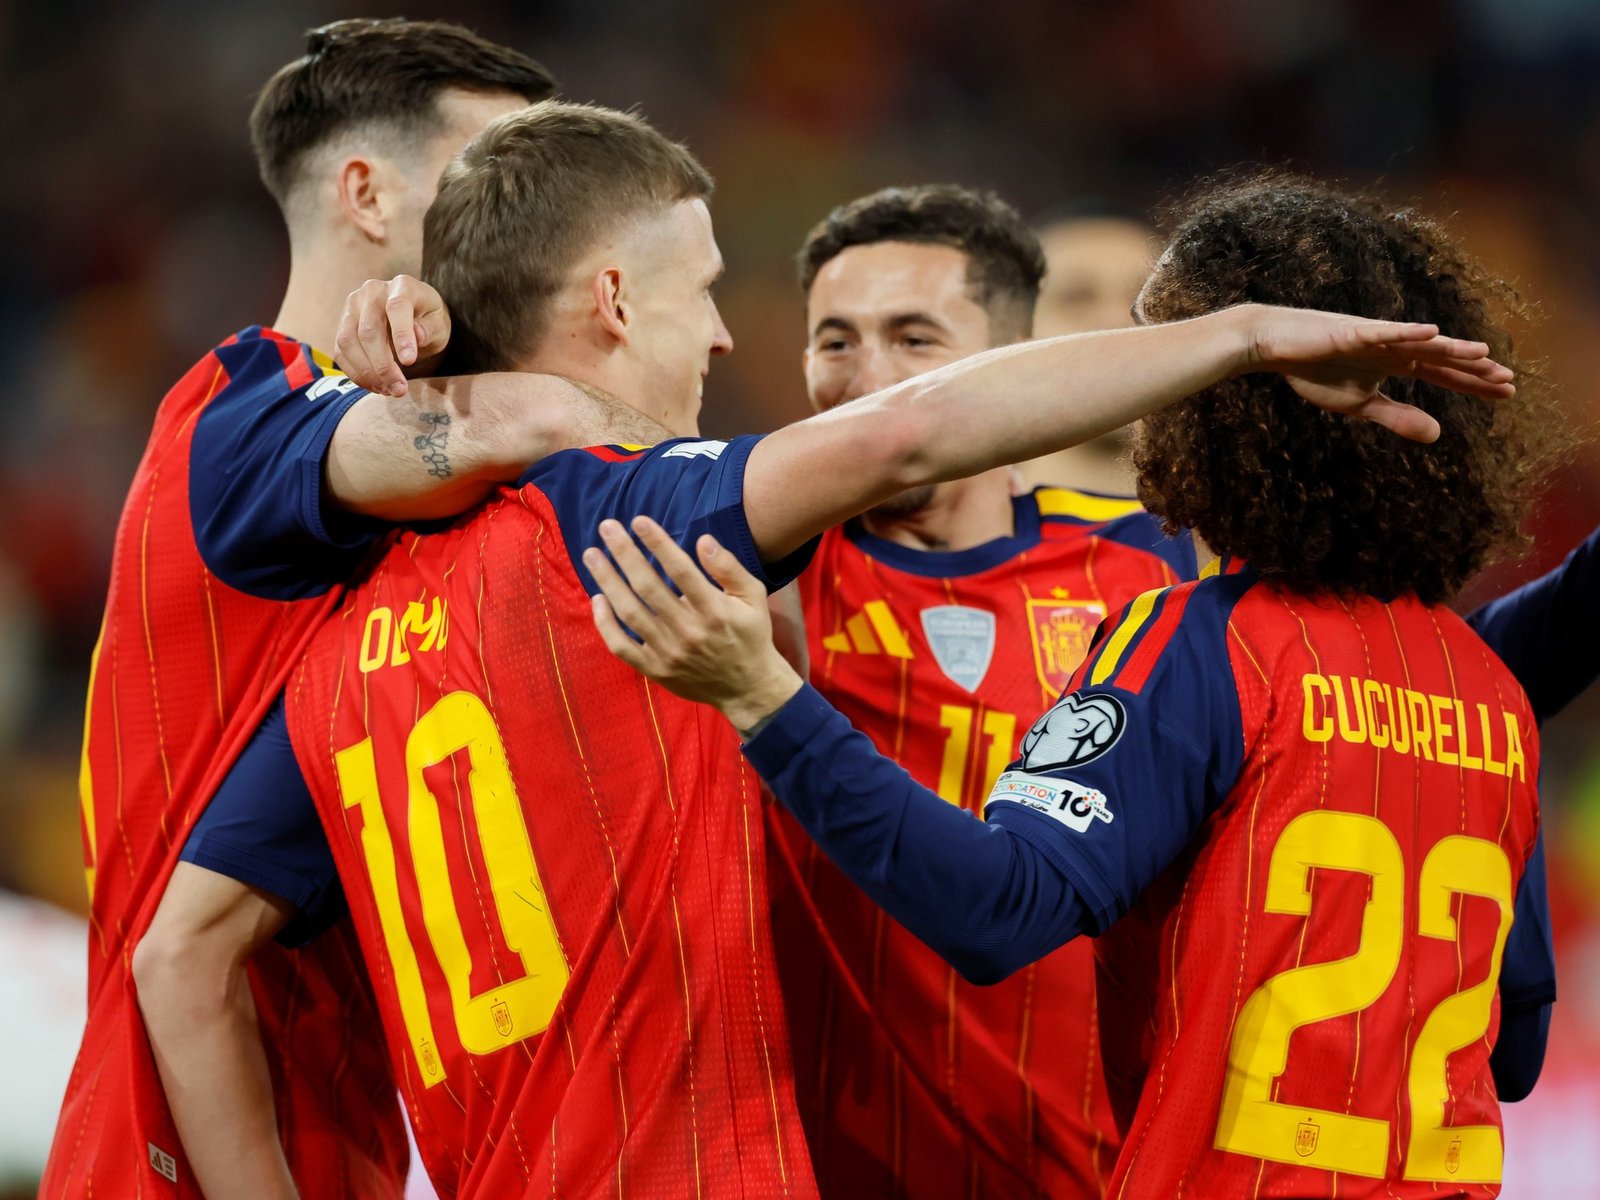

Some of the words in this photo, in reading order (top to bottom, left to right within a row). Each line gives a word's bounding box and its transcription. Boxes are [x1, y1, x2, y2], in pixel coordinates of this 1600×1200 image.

[937, 703, 1016, 823] 11
[1302, 673, 1525, 784] CUCURELLA
[1058, 789, 1093, 818] 10
[335, 690, 570, 1090] 10
[1213, 809, 1515, 1184] 22
